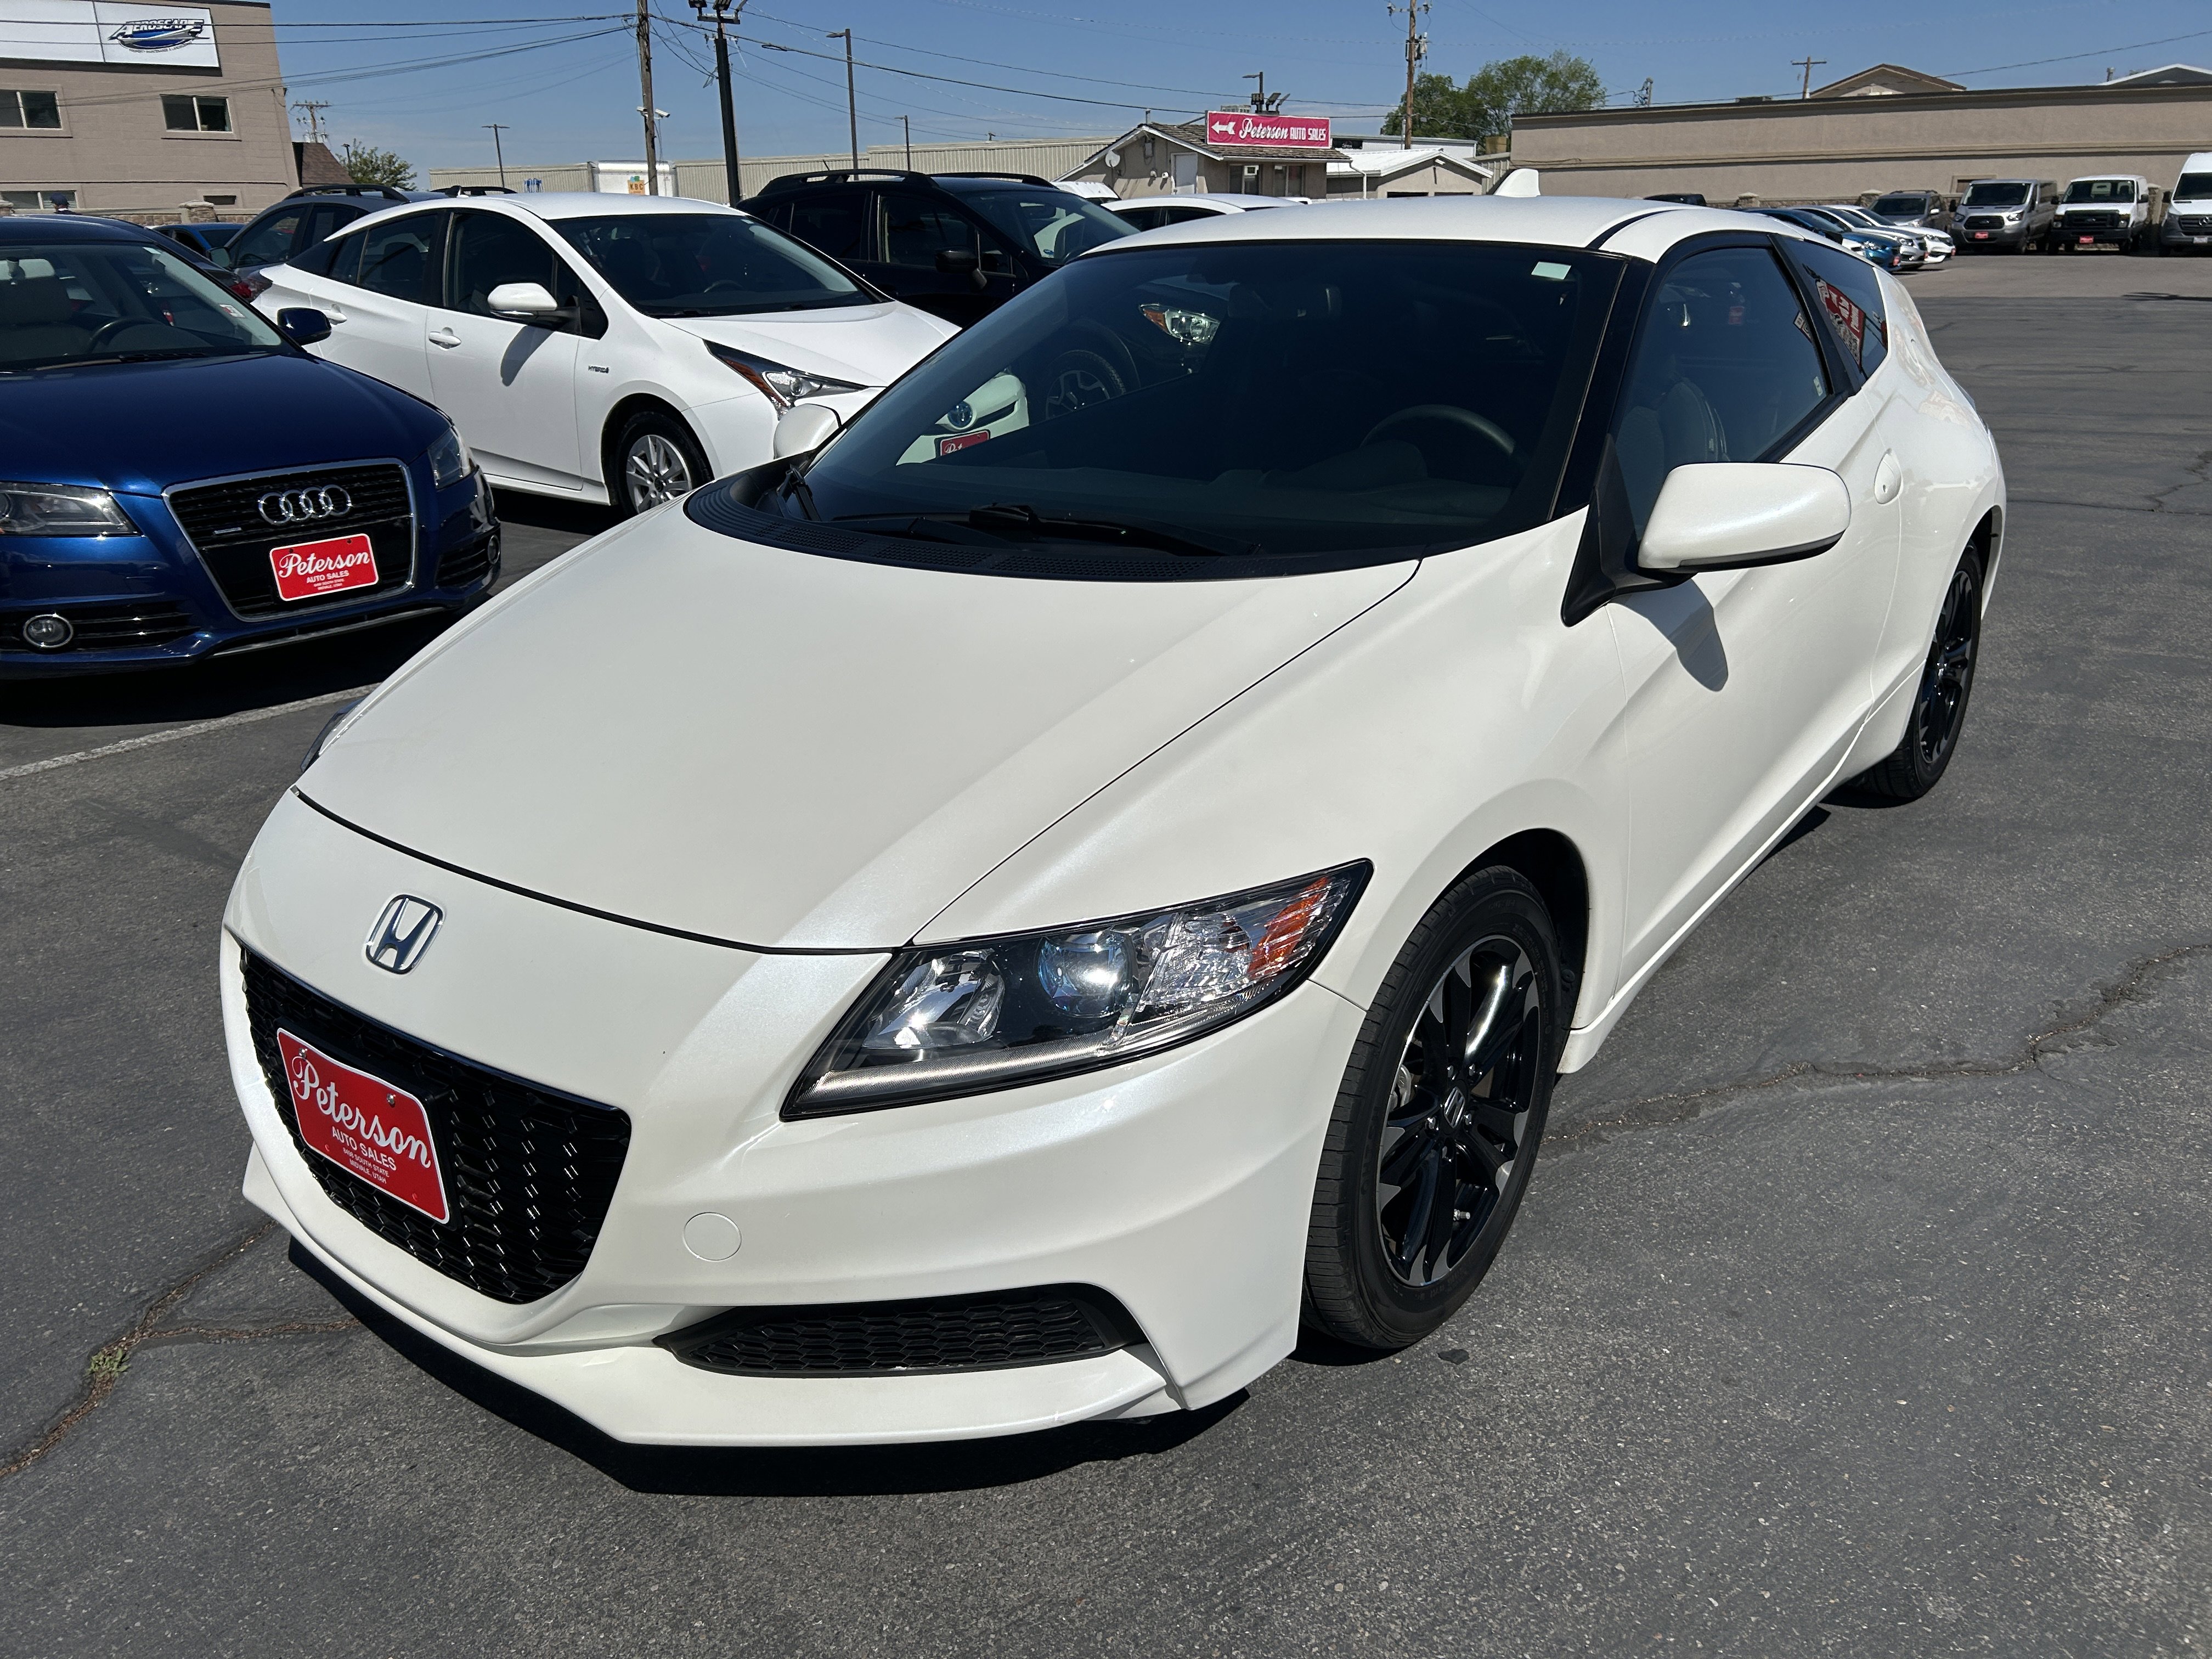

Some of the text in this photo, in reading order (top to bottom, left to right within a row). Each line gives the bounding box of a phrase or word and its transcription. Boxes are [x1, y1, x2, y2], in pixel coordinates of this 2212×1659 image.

[108, 19, 205, 40] AEROSCAPE
[1239, 118, 1326, 141] Peterson AUTO SALES
[278, 552, 370, 578] Peterson
[307, 574, 325, 583] AUTO
[326, 570, 350, 579] SALES
[292, 1056, 431, 1168] Peterson
[332, 1126, 396, 1171] AUTO SALES
[372, 1172, 386, 1184] UTAH
[373, 1164, 390, 1177] STATE
